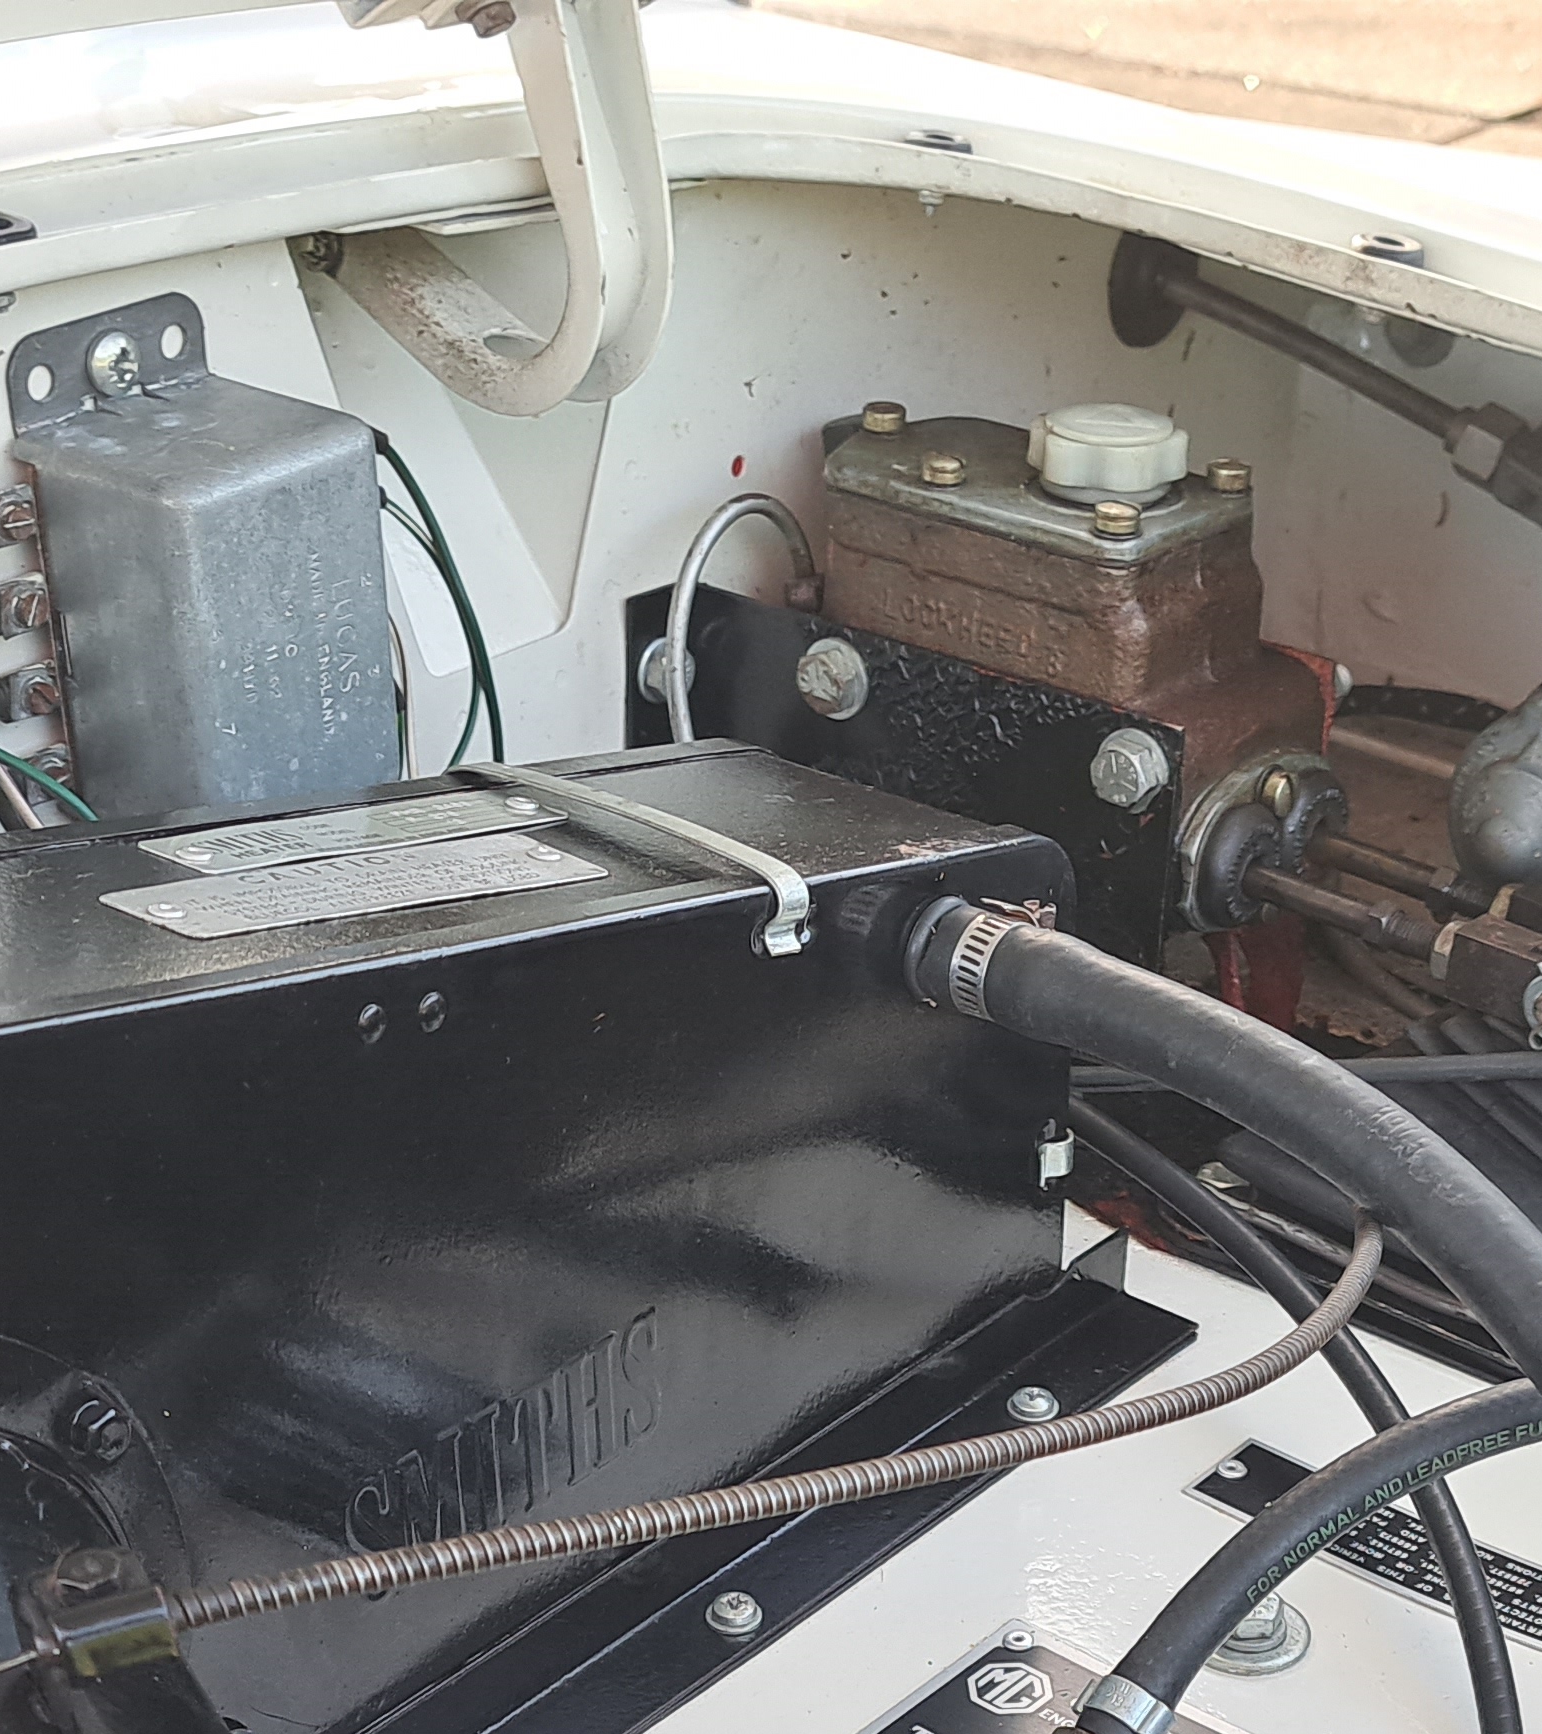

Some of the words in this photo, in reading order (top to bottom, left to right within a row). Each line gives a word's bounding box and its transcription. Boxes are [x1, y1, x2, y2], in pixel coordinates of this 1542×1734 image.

[331, 579, 360, 693] LUCAS
[230, 840, 315, 861] HEATER
[238, 852, 416, 886] CAUTION
[1245, 1567, 1284, 1605] FOR
[1283, 1505, 1361, 1572] NORMAL
[1363, 1477, 1405, 1513] AND
[1396, 1528, 1429, 1544] AND
[1345, 1540, 1387, 1560] MORE
[1373, 1564, 1409, 1581] THIS
[977, 1667, 1040, 1711] MG
